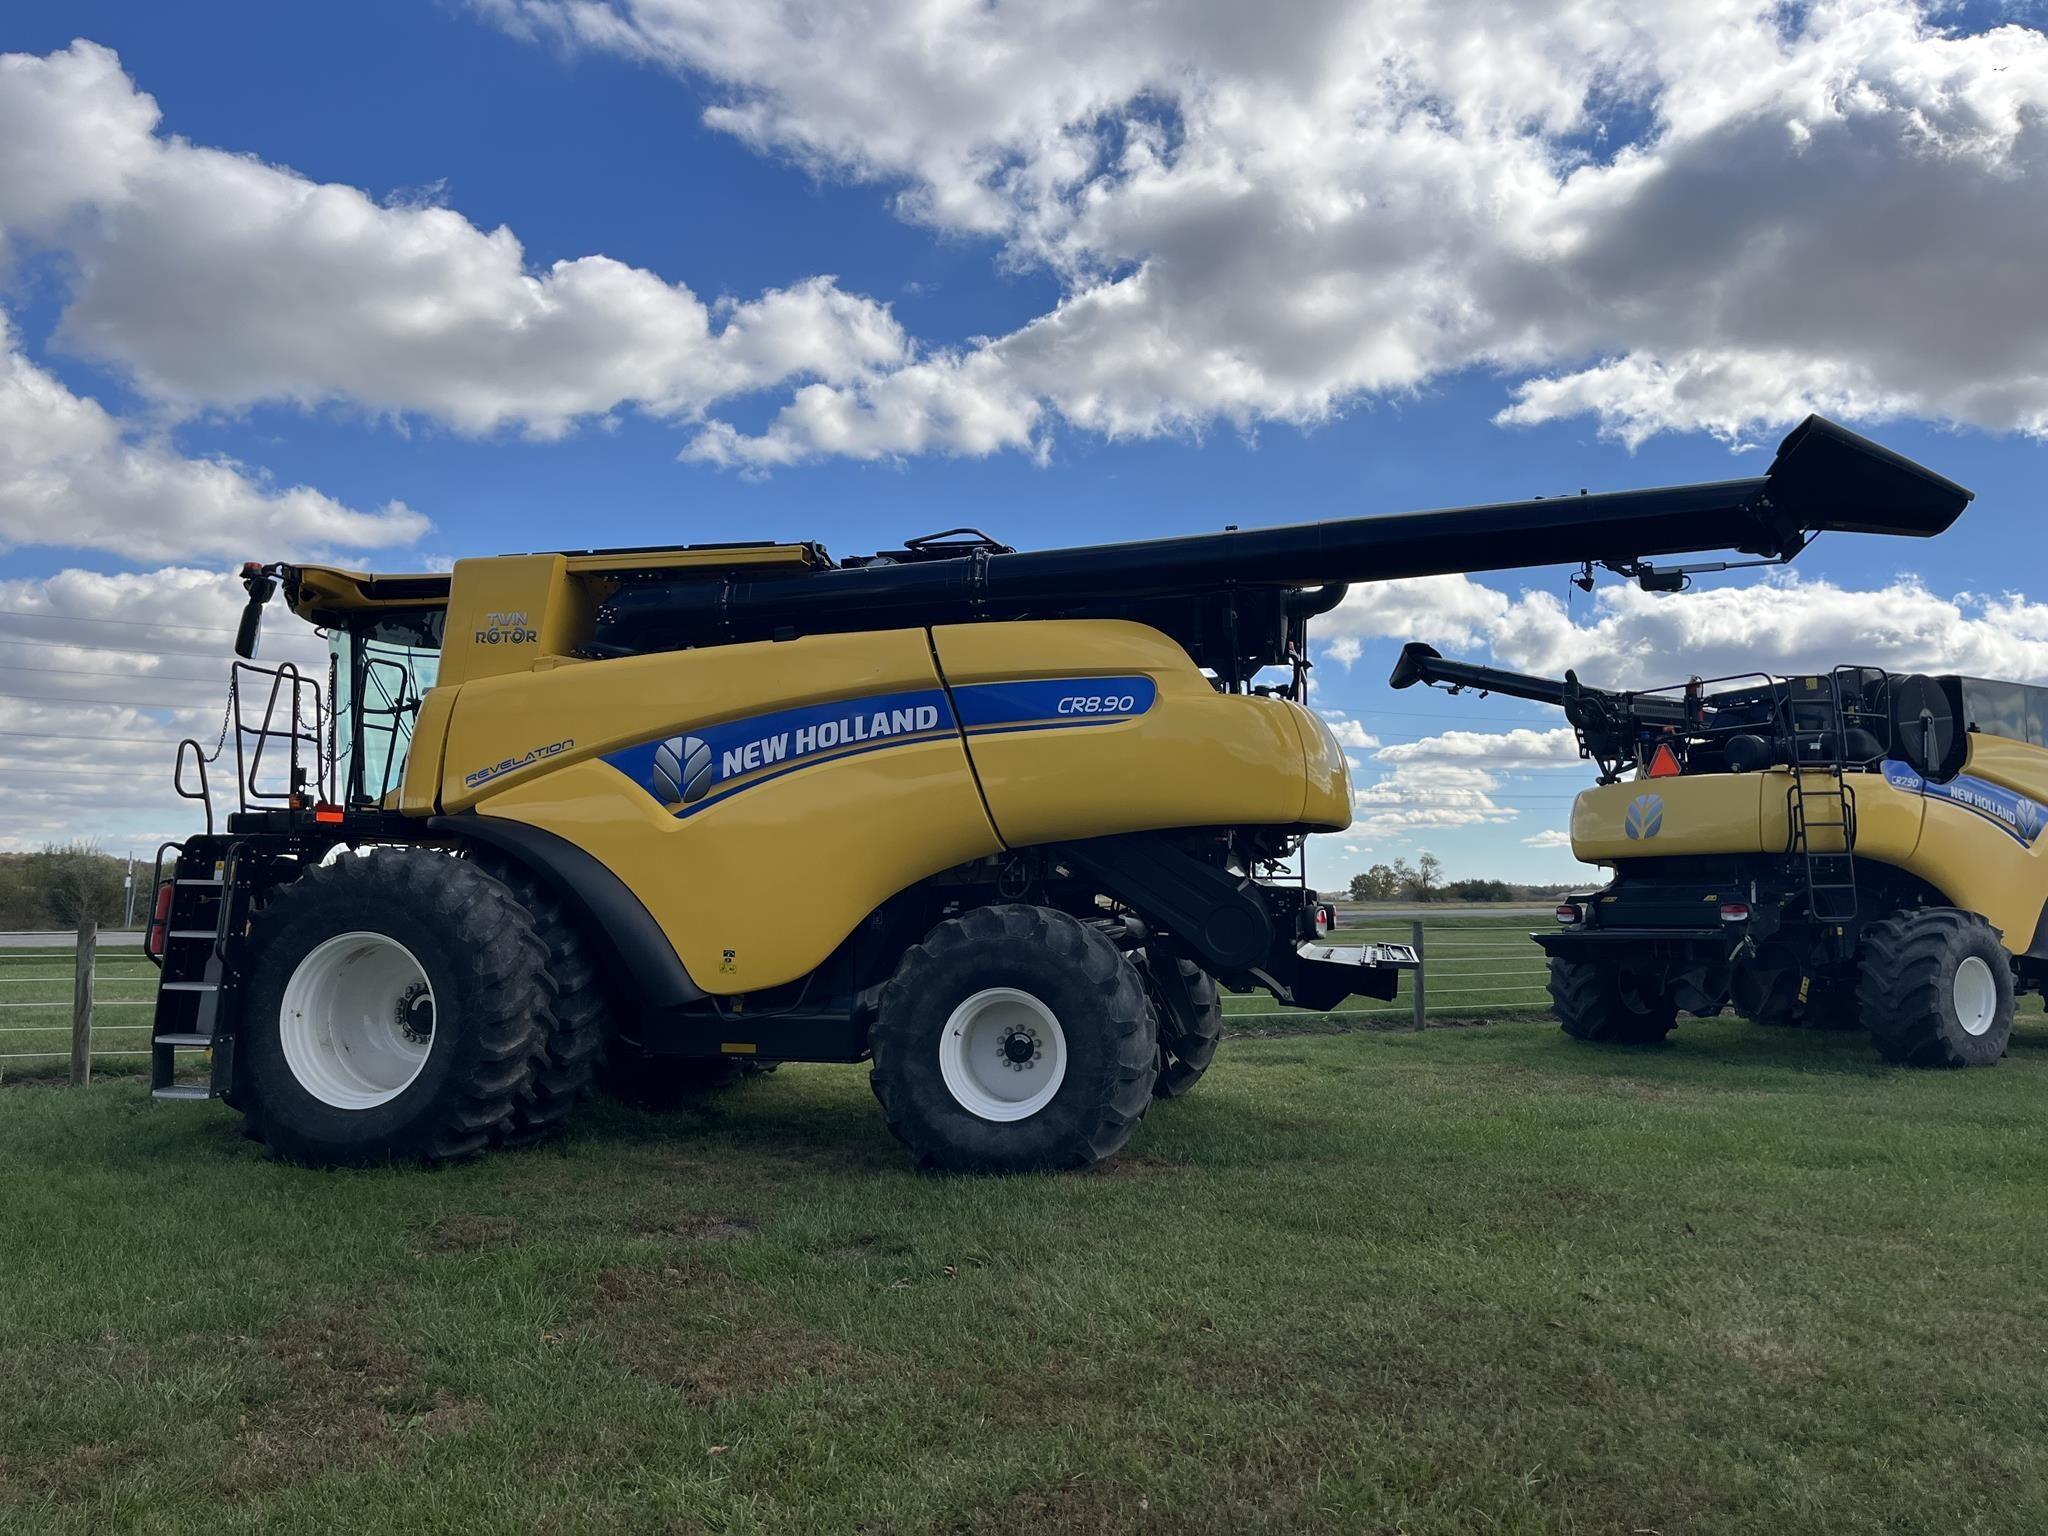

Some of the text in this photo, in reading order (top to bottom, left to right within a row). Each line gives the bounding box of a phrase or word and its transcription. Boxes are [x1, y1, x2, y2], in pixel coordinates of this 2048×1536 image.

[487, 612, 528, 626] TWIN
[475, 627, 537, 644] ROTOR
[1057, 695, 1134, 713] CR8.90
[722, 705, 938, 778] NEW HOLLAND
[465, 739, 574, 784] REVELATION
[1950, 786, 2016, 825] NEW HOLLAND
